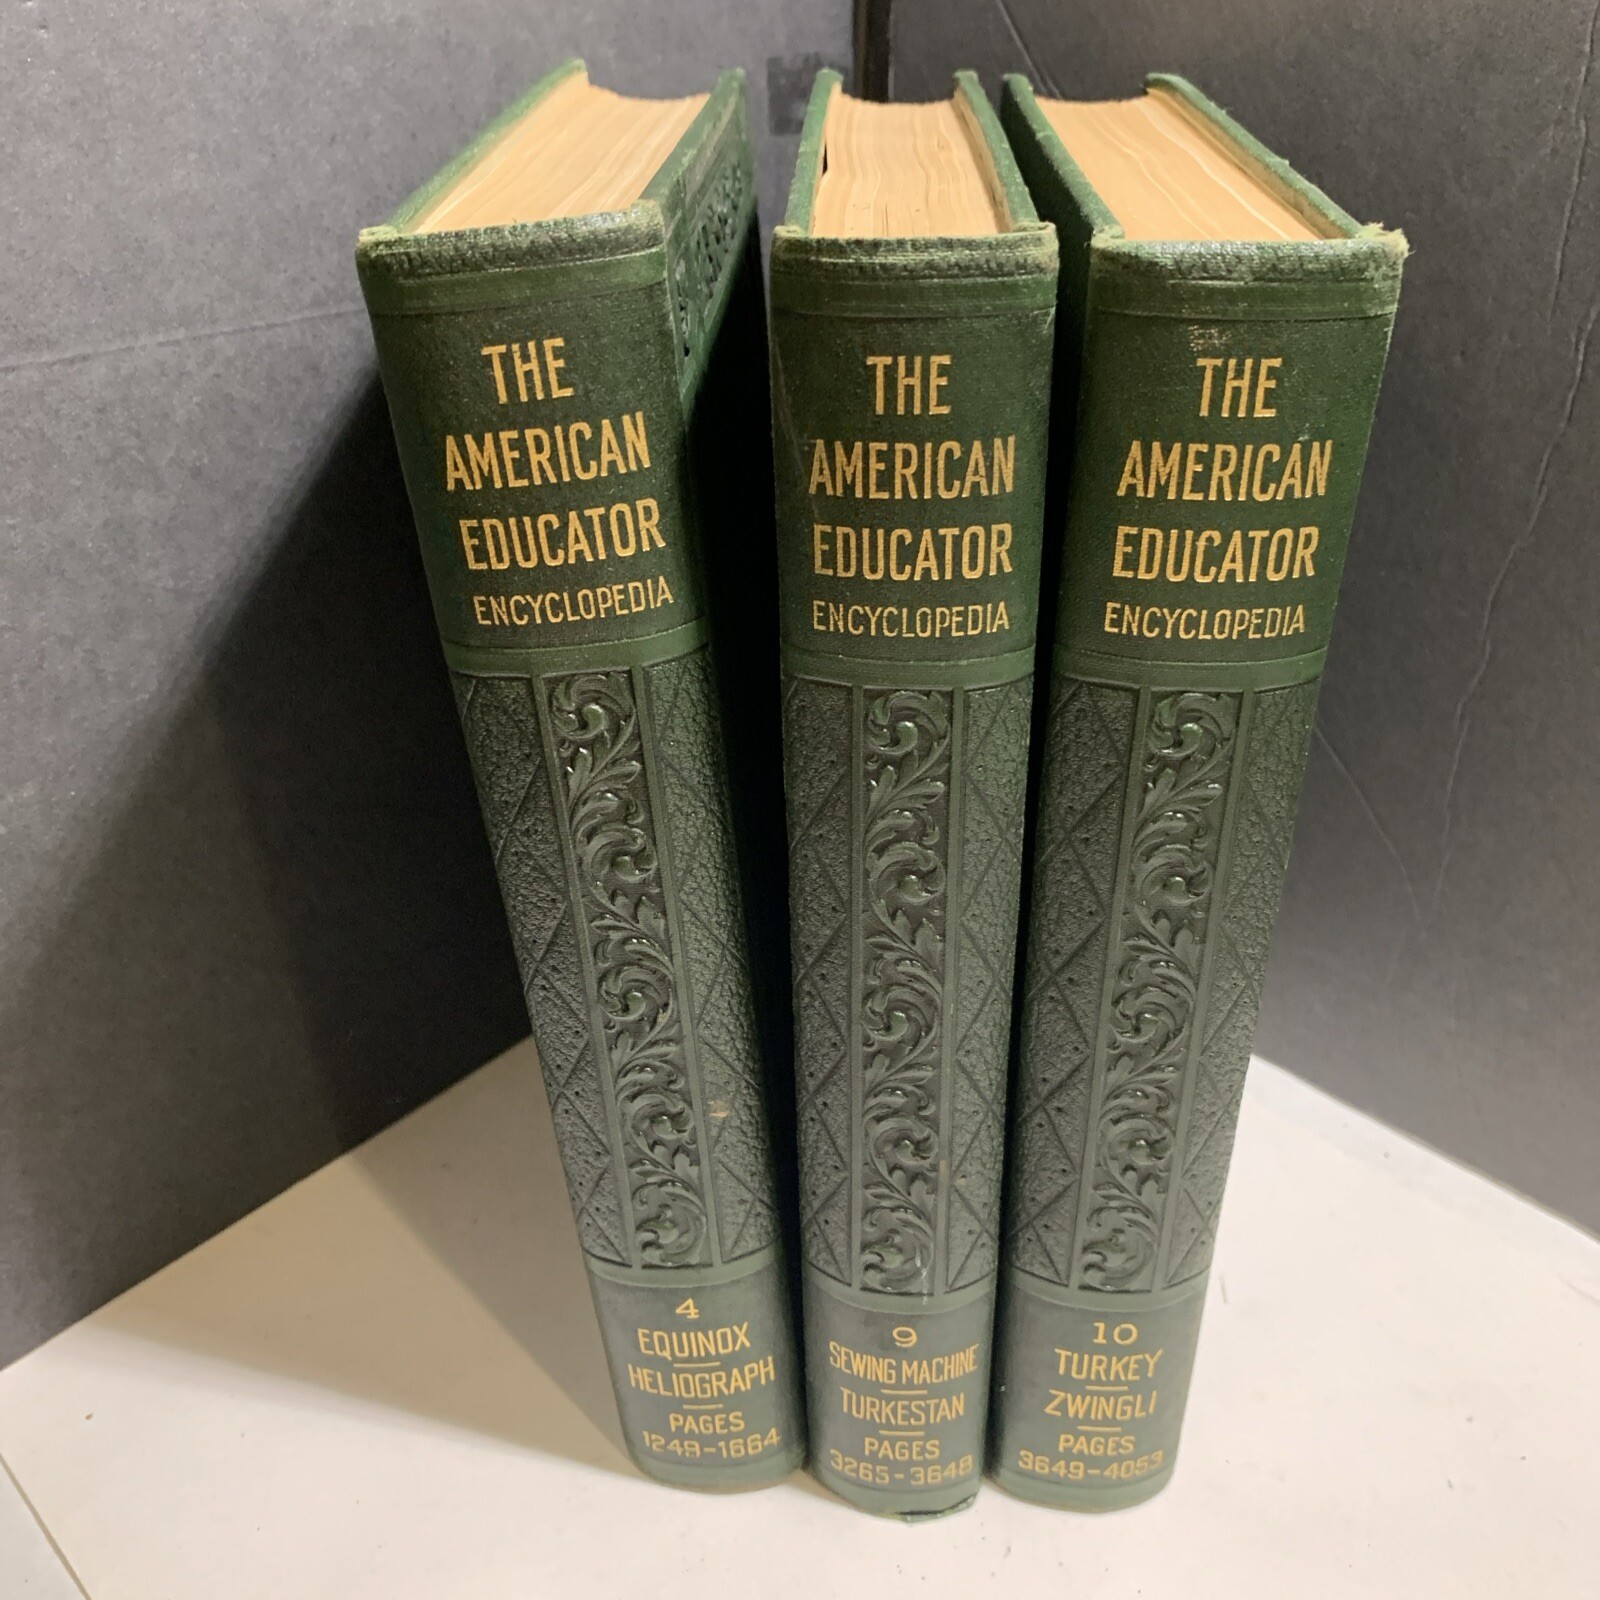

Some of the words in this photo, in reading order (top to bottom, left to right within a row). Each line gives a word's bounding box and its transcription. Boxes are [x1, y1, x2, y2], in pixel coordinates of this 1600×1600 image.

[481, 337, 575, 406] THE
[866, 354, 952, 416] THE
[1196, 357, 1282, 419] THE
[445, 410, 651, 492] AMERICAN
[809, 435, 1015, 501] AMERICAN
[1117, 438, 1334, 502] AMERICAN
[458, 498, 667, 572] EDUCATOR
[813, 522, 1013, 583] EDUCATOR
[1111, 524, 1320, 583] EDUCATOR
[474, 576, 674, 628] ENCYCLOPEDIA
[811, 600, 1010, 639] ENCYCLOPEDIA
[1103, 602, 1306, 640] ENCYCLOPEDIA
[676, 1298, 700, 1319] 4
[637, 1322, 752, 1359] EQUINOX
[892, 1326, 917, 1348] 9
[1092, 1322, 1139, 1346] 10
[628, 1356, 776, 1399] HELIOGRAPH
[829, 1342, 897, 1385] SEWING
[901, 1344, 979, 1385] MACHINE
[1054, 1348, 1164, 1380] TURKEY
[669, 1411, 746, 1434] PAGES
[839, 1386, 965, 1426] TURKESTAN
[1043, 1389, 1158, 1422] ZWINGLI
[642, 1429, 782, 1458] 1249-1664
[864, 1437, 941, 1460] PAGES
[1058, 1434, 1135, 1455] PAGES
[1018, 1449, 1166, 1481] 3649-4053
